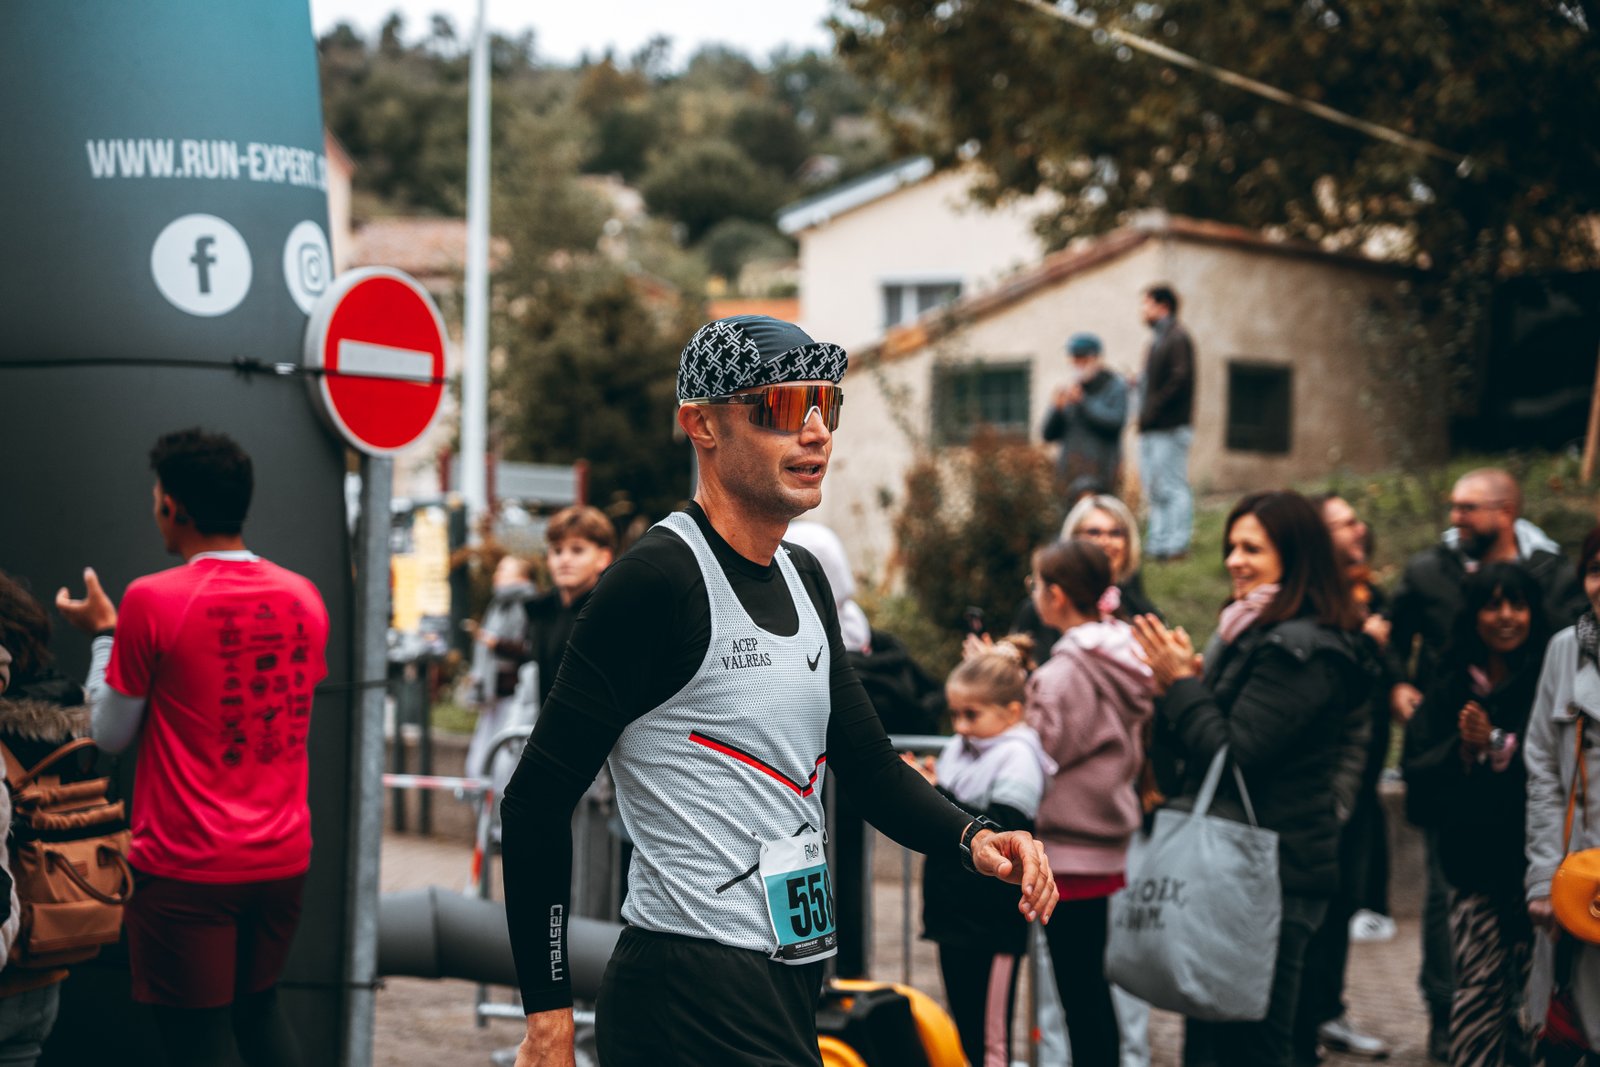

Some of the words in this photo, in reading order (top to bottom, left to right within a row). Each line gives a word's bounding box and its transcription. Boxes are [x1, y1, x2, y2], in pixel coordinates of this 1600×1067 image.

[732, 637, 758, 653] ACEP
[721, 652, 772, 670] VALREAS
[786, 870, 835, 937] 558
